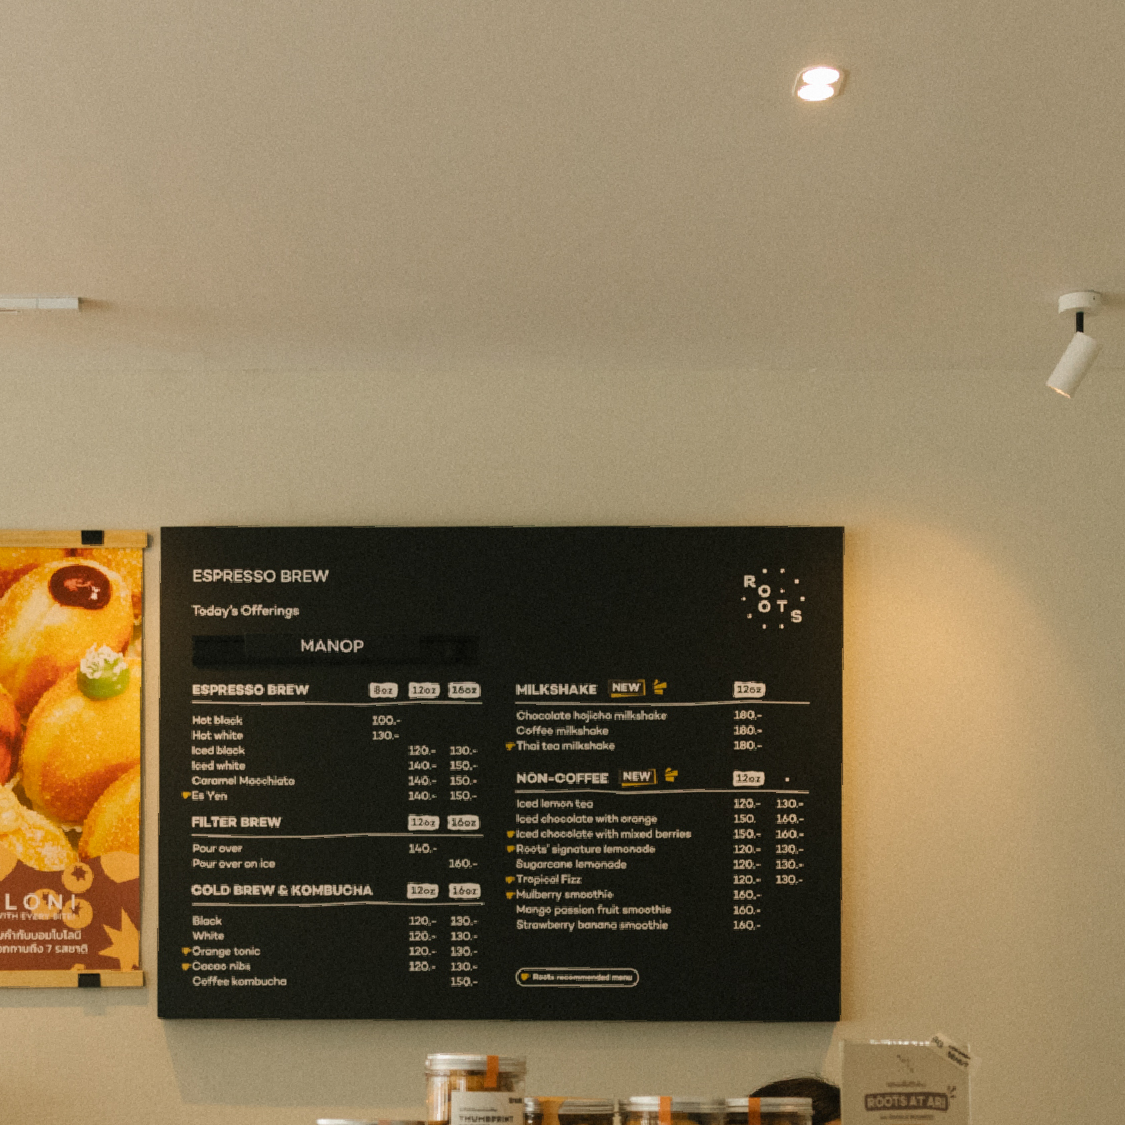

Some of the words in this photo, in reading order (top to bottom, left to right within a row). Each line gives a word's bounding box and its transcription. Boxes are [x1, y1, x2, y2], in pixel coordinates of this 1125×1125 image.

[192, 568, 277, 584] ESPRESSO
[280, 569, 330, 583] BREW
[191, 604, 239, 619] Today's
[240, 603, 300, 620] Offerings
[300, 638, 365, 654] MANOP
[191, 683, 266, 697] ESPRESSO
[267, 683, 310, 696] BREW
[515, 683, 597, 696] MILKSHAKE
[612, 682, 642, 693] NEW
[192, 715, 213, 725] Hot
[213, 714, 243, 726] black
[515, 709, 572, 721] Chocolate
[613, 709, 668, 721] milkshake
[192, 729, 213, 741] Hot
[213, 729, 244, 741] white
[515, 725, 554, 736] Coffee
[556, 724, 610, 736] milkshake
[191, 745, 215, 756] Iced
[215, 745, 246, 756] black
[516, 740, 540, 751] Thai
[541, 741, 561, 751] tea
[561, 740, 616, 752] milkshake
[191, 760, 215, 771] Iced
[215, 759, 246, 771] white
[191, 775, 237, 786] Caramel
[239, 775, 296, 787] Macchiato
[516, 771, 609, 785] NON-COFFEE
[622, 771, 651, 782] NEW
[191, 790, 205, 800] Es
[205, 790, 228, 801] Yen
[516, 798, 539, 809] Iced
[541, 798, 574, 809] lemon
[574, 799, 594, 809] tea
[191, 815, 238, 828] FILTER
[240, 816, 282, 829] BREW
[515, 813, 539, 824] Iced
[540, 812, 594, 824] chocolate
[594, 813, 619, 824] with
[620, 815, 658, 827] orange
[515, 828, 539, 839] Iced
[540, 828, 594, 840] chocolate
[594, 828, 619, 839] with
[620, 828, 653, 839] mixed
[654, 829, 692, 839] berries
[192, 843, 218, 854] Pour
[218, 845, 243, 854] over
[551, 843, 602, 857] signature
[603, 843, 656, 854] lemonade
[192, 858, 218, 869] Pour
[218, 859, 243, 869] over
[243, 860, 258, 869] on
[260, 857, 276, 869] ice
[515, 858, 573, 871] Sugarcane
[575, 858, 628, 870] lemonade
[515, 873, 560, 887] Tropical
[560, 873, 583, 885] Fizz
[190, 883, 232, 896] COLD
[233, 883, 276, 897] BREW
[277, 884, 289, 897] &
[290, 883, 374, 897] KOMBUCHA
[515, 888, 563, 903] Mulberry
[564, 889, 615, 899] smoothie
[516, 904, 552, 917] Mango
[553, 904, 595, 917] passion
[596, 903, 620, 915] fruit
[622, 904, 672, 915] smoothie
[192, 915, 223, 926] Black
[516, 918, 576, 933] Strawberry
[577, 920, 618, 931] banana
[618, 919, 669, 931] smoothie
[192, 930, 225, 941] White
[190, 945, 232, 959] Orange
[233, 946, 261, 956] tonic
[191, 961, 227, 971] Cacao
[229, 961, 251, 972] nibs
[192, 975, 230, 987] Coffee
[231, 975, 288, 987] kombucha
[867, 1096, 908, 1108] ROOTS
[909, 1096, 925, 1107] AT
